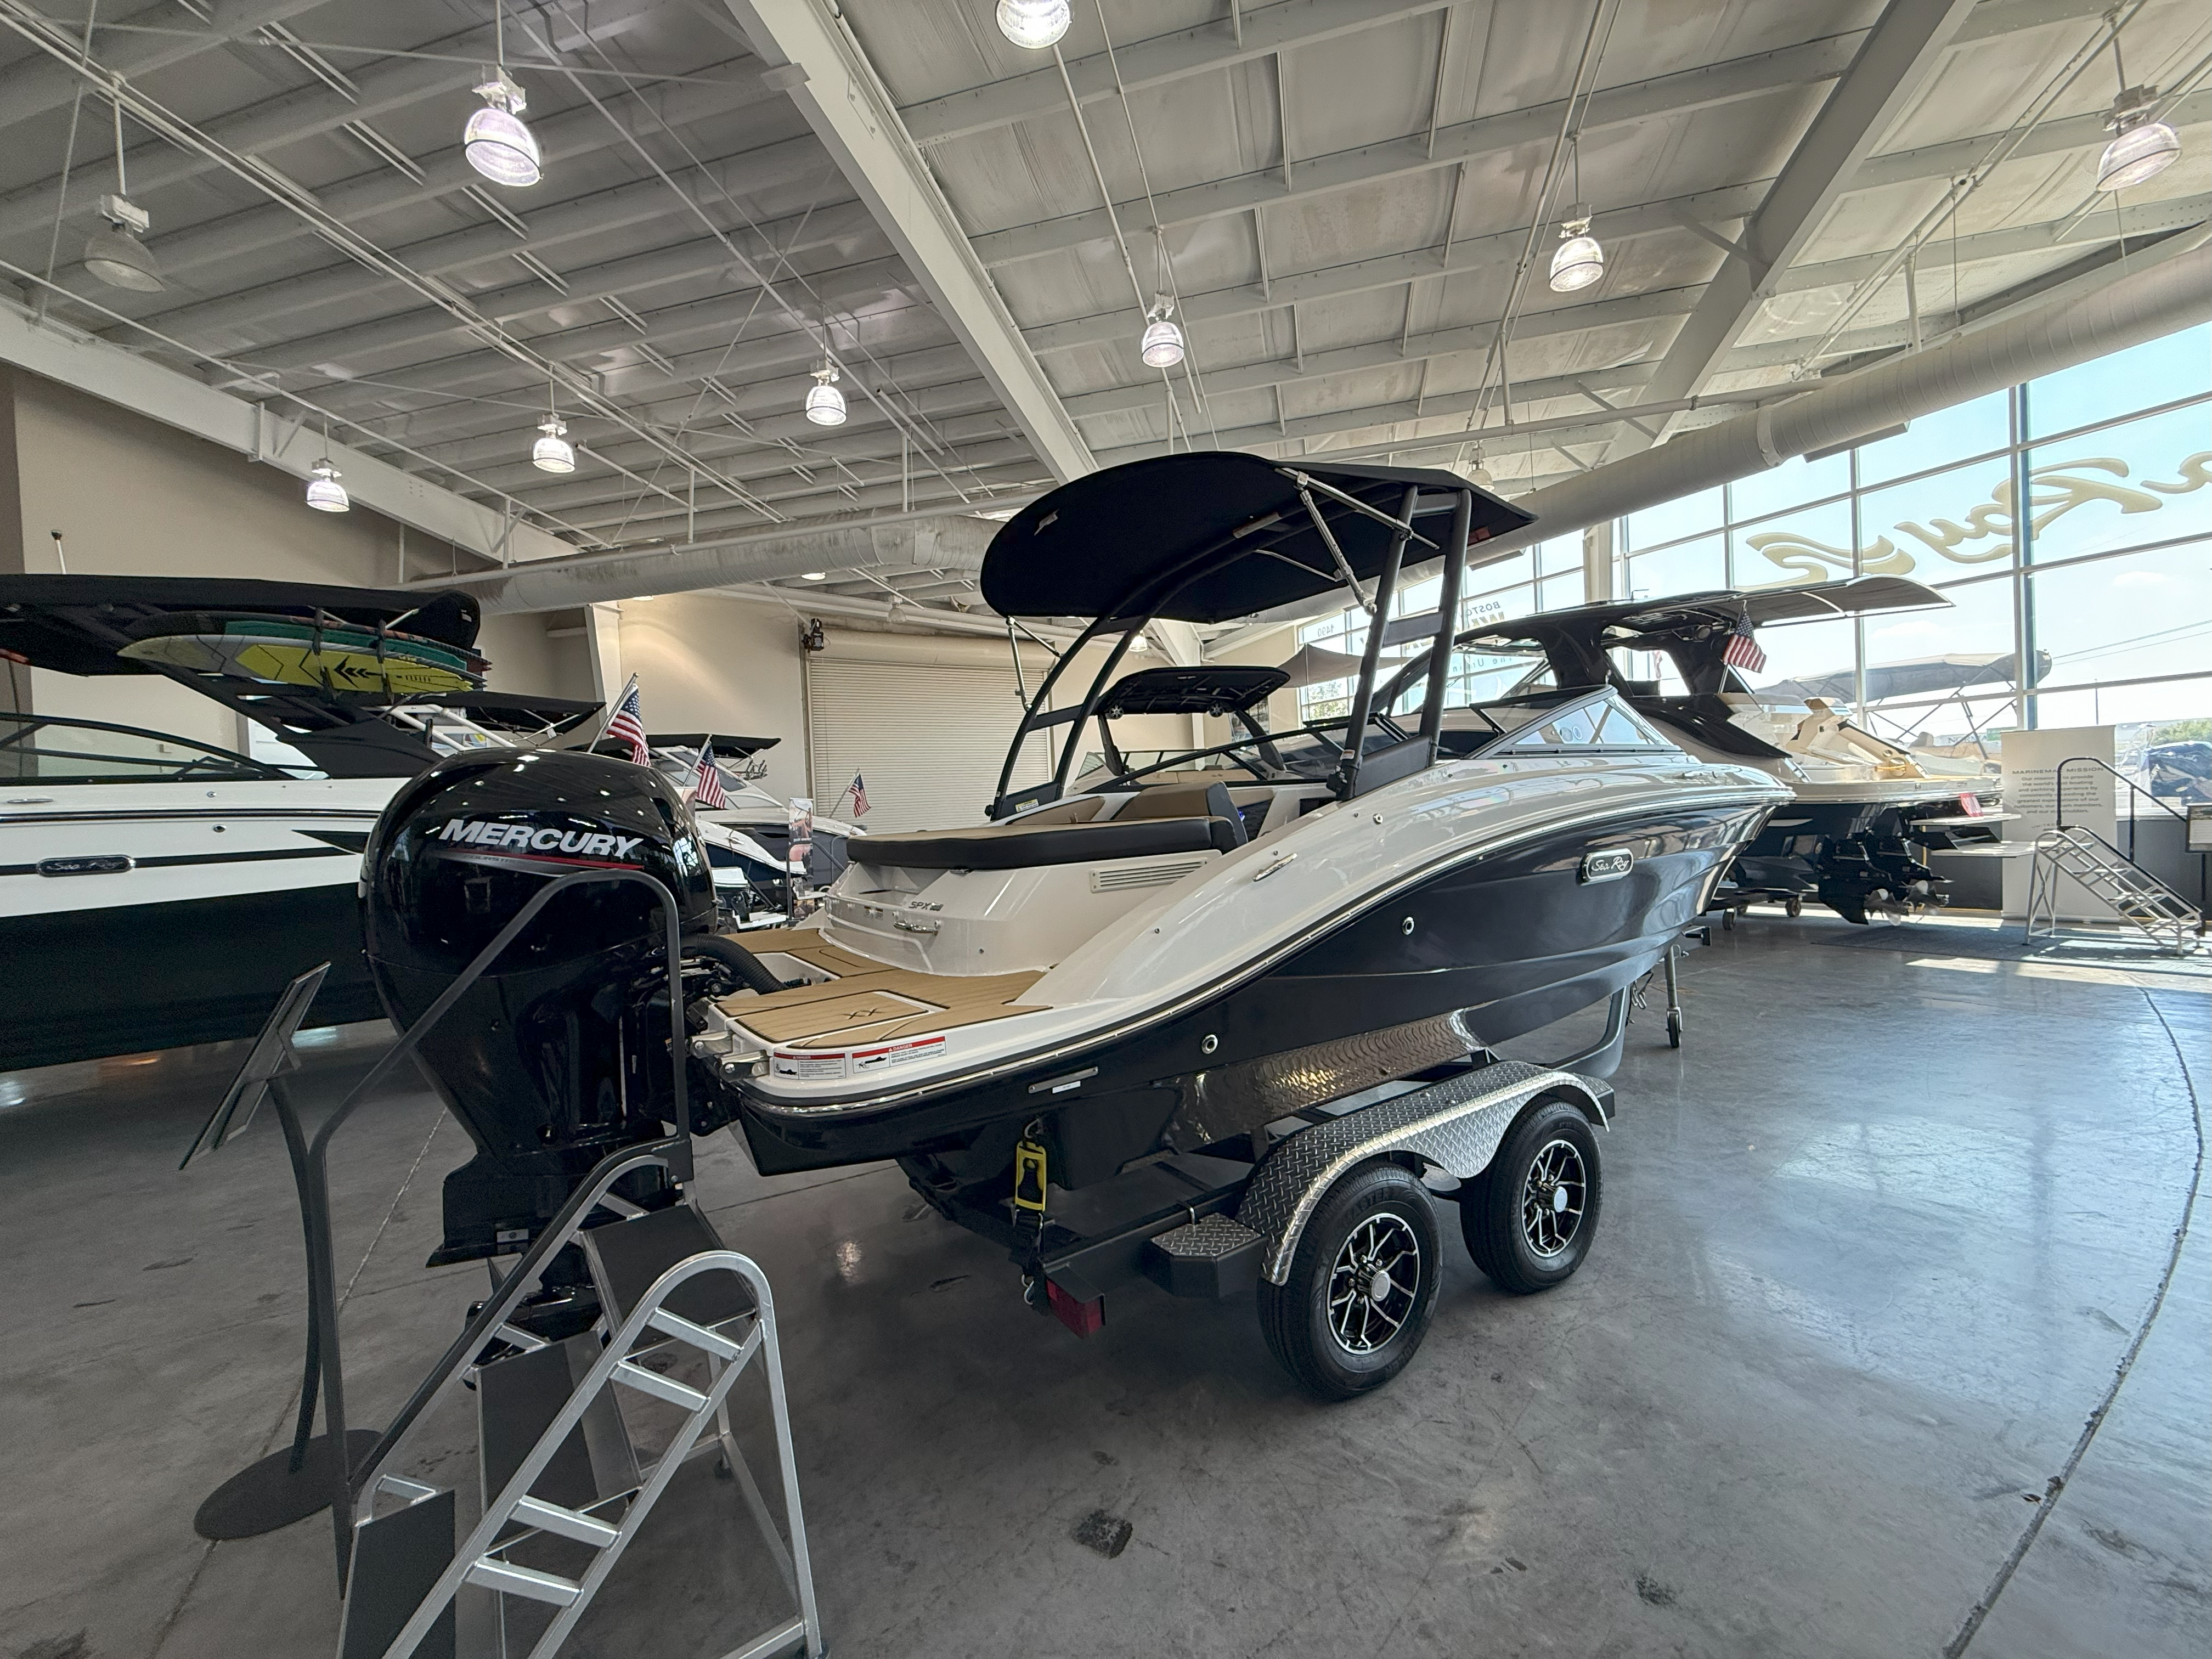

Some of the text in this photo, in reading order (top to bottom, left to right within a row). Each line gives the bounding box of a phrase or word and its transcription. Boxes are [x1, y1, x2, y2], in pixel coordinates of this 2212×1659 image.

[439, 819, 644, 859] MERCURY
[1592, 856, 1630, 871] Sea Ray
[909, 901, 932, 910] SPX
